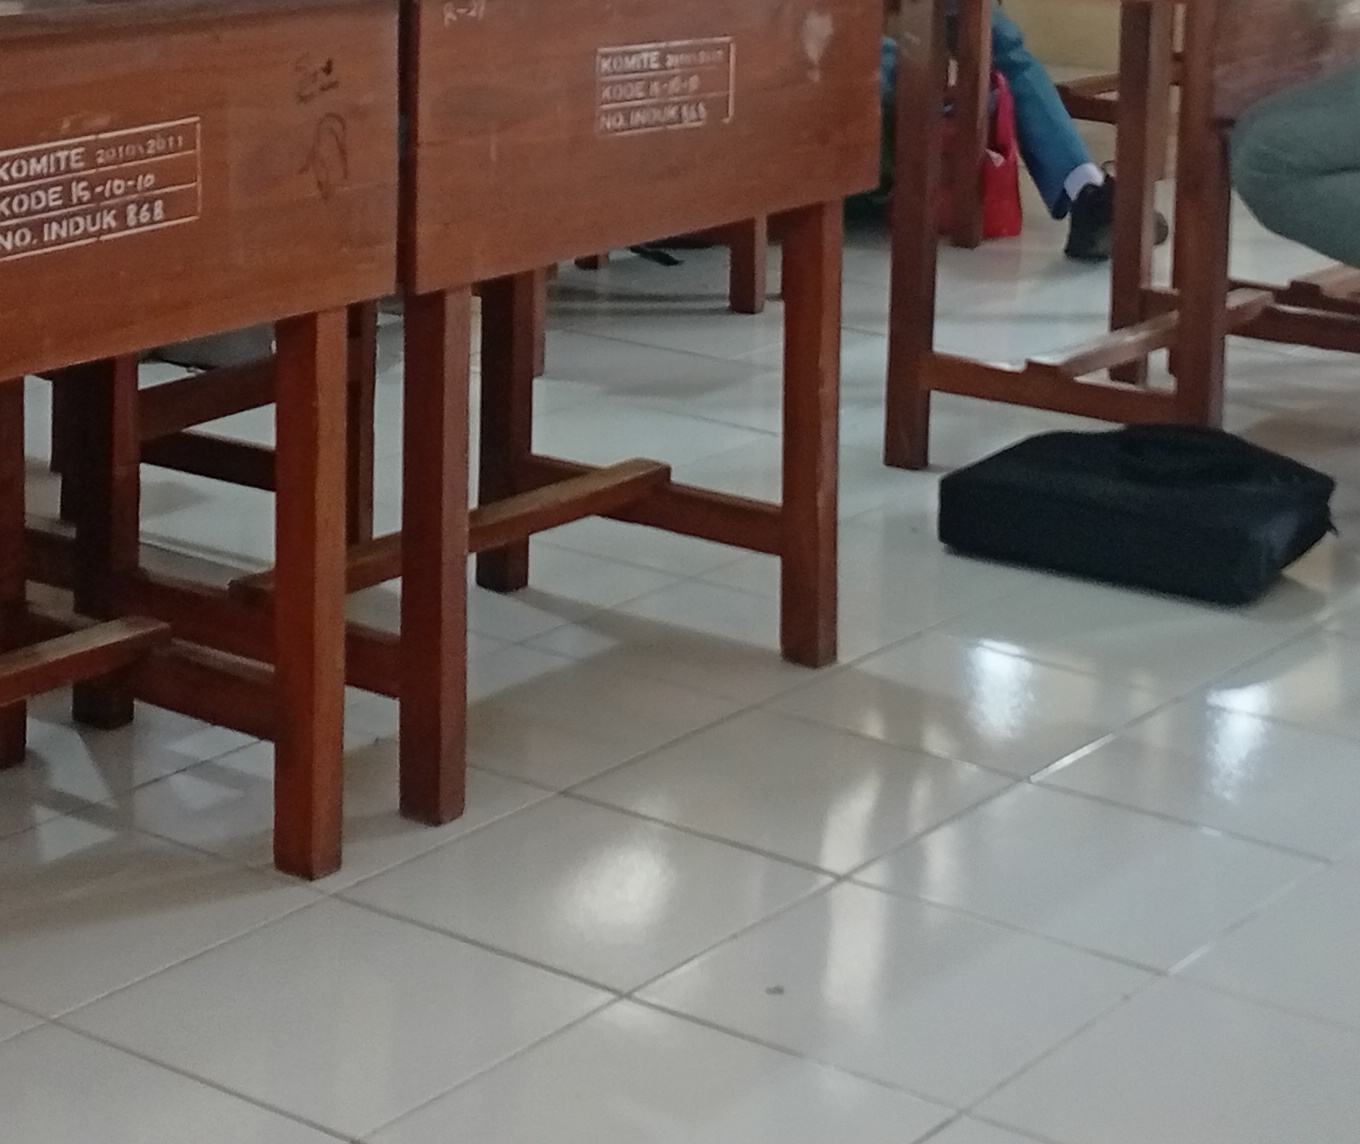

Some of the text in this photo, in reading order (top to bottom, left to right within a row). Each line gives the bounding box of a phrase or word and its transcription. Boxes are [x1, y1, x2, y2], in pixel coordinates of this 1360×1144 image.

[600, 51, 660, 73] KOMITE
[601, 80, 647, 102] KODE
[630, 105, 680, 128] INDUK
[43, 209, 117, 241] INDUK
